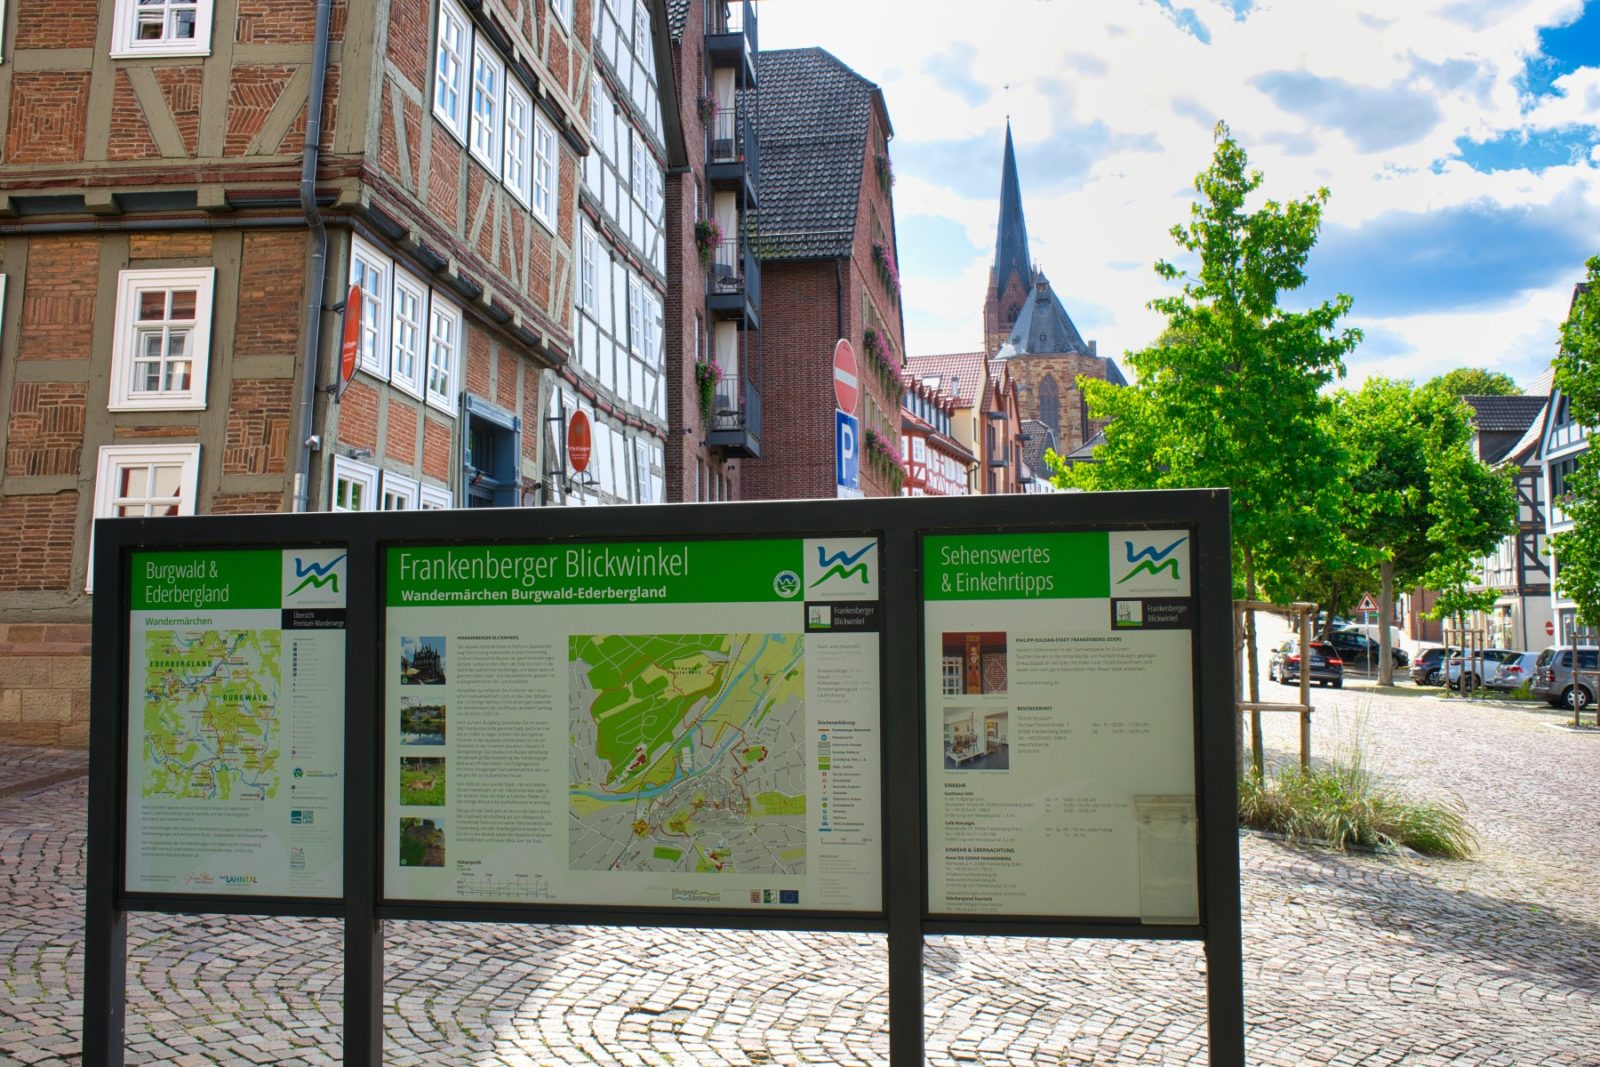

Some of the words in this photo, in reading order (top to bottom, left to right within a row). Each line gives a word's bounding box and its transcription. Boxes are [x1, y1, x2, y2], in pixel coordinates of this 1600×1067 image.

[842, 422, 855, 480] P
[941, 545, 1051, 566] Sehenswertes
[400, 550, 558, 587] Frankenberger
[566, 546, 688, 577] Blickwinkel
[146, 561, 205, 584] Burgwald
[209, 561, 218, 578] &
[941, 574, 952, 592] &
[956, 571, 1054, 596] Einkehrtipps
[145, 584, 230, 607] Ederbergland
[401, 588, 508, 601] Wandermärchen
[511, 586, 667, 602] Burgwald-Ederbergland
[834, 605, 875, 616] Frankenberger
[1147, 604, 1188, 614] Frankenberger
[145, 616, 213, 626] Wandermärchen
[834, 616, 865, 625] Blickwinkel
[1147, 614, 1179, 623] Blickwinkel
[150, 660, 213, 668] EDERBERGLAND
[223, 694, 268, 702] BURGWALD
[226, 875, 258, 884] LAHNTAL
